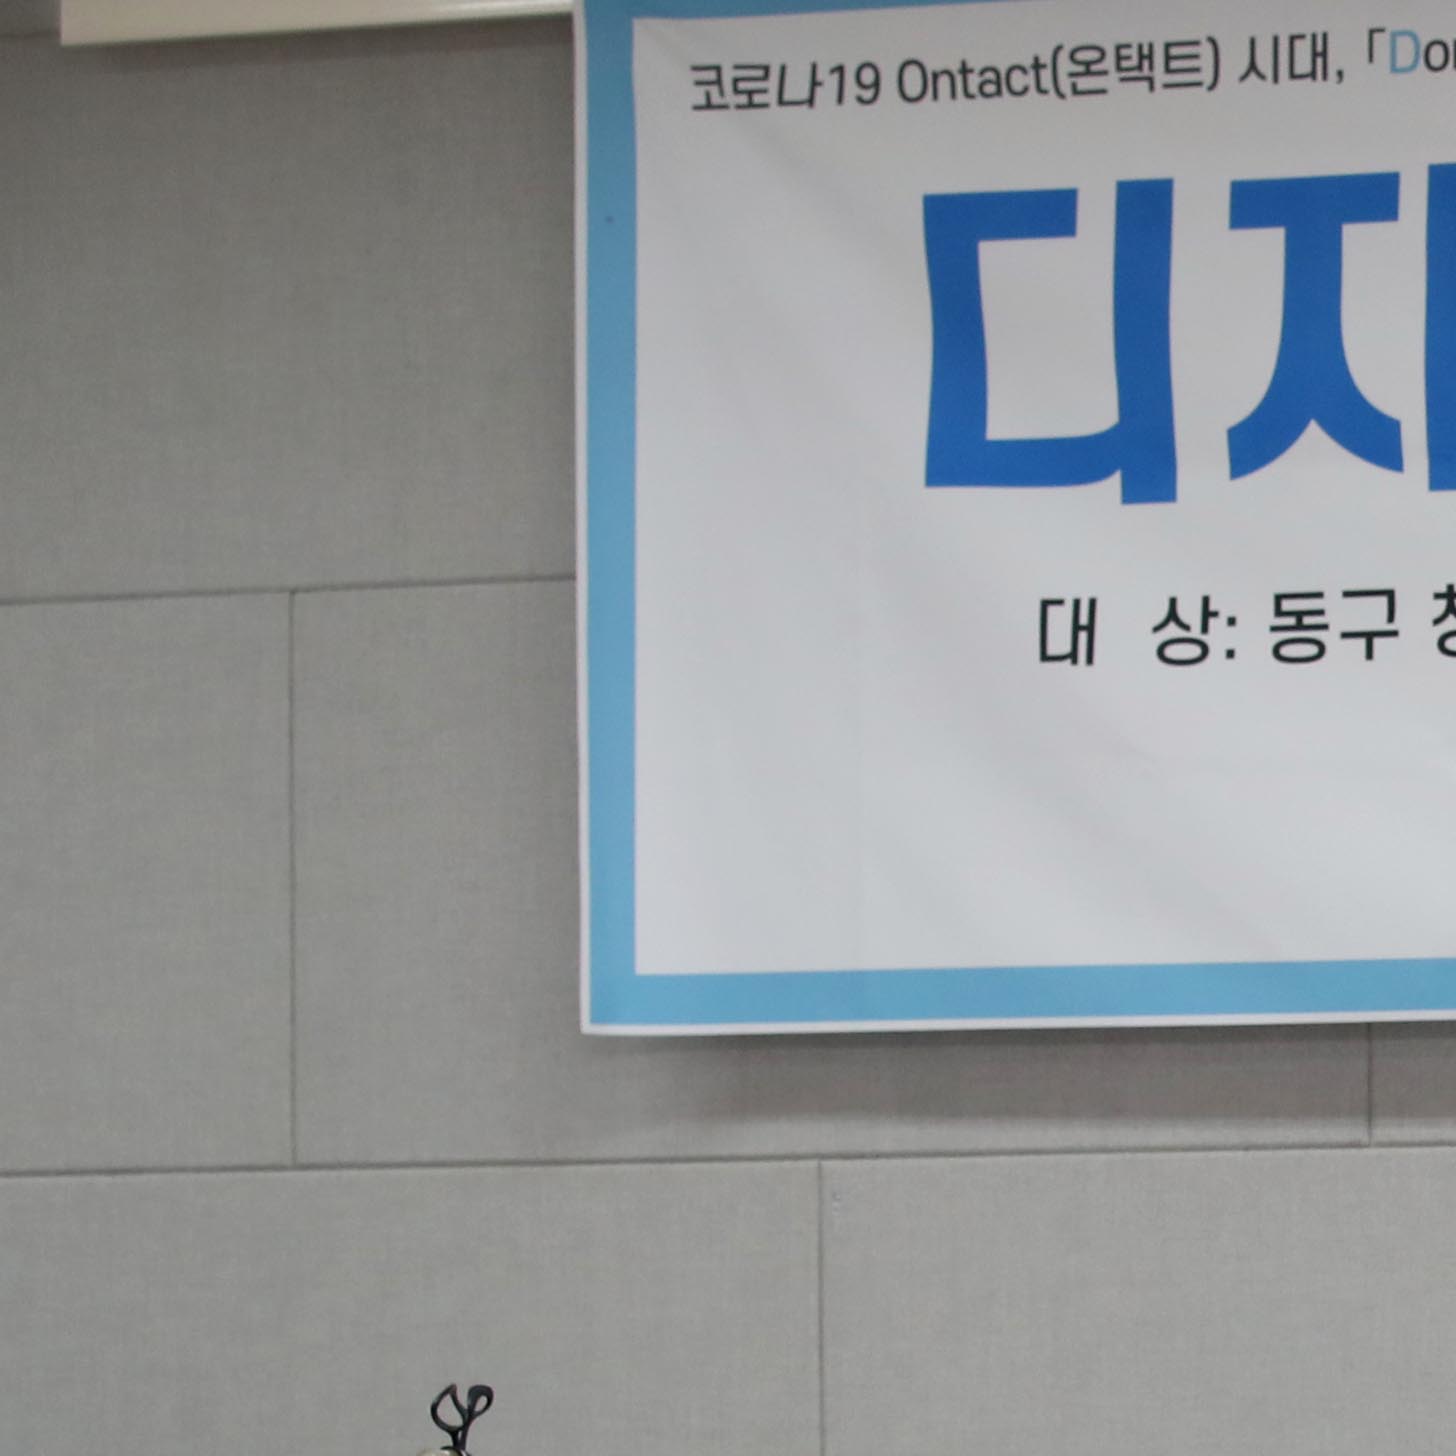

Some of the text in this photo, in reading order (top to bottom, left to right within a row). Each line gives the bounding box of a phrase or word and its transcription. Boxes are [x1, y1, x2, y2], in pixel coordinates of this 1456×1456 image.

[691, 62, 880, 110] 코로나19
[898, 37, 1219, 103] Ontact(온택트)
[1240, 32, 1343, 84] 시대,
[1269, 589, 1399, 664] 동구
